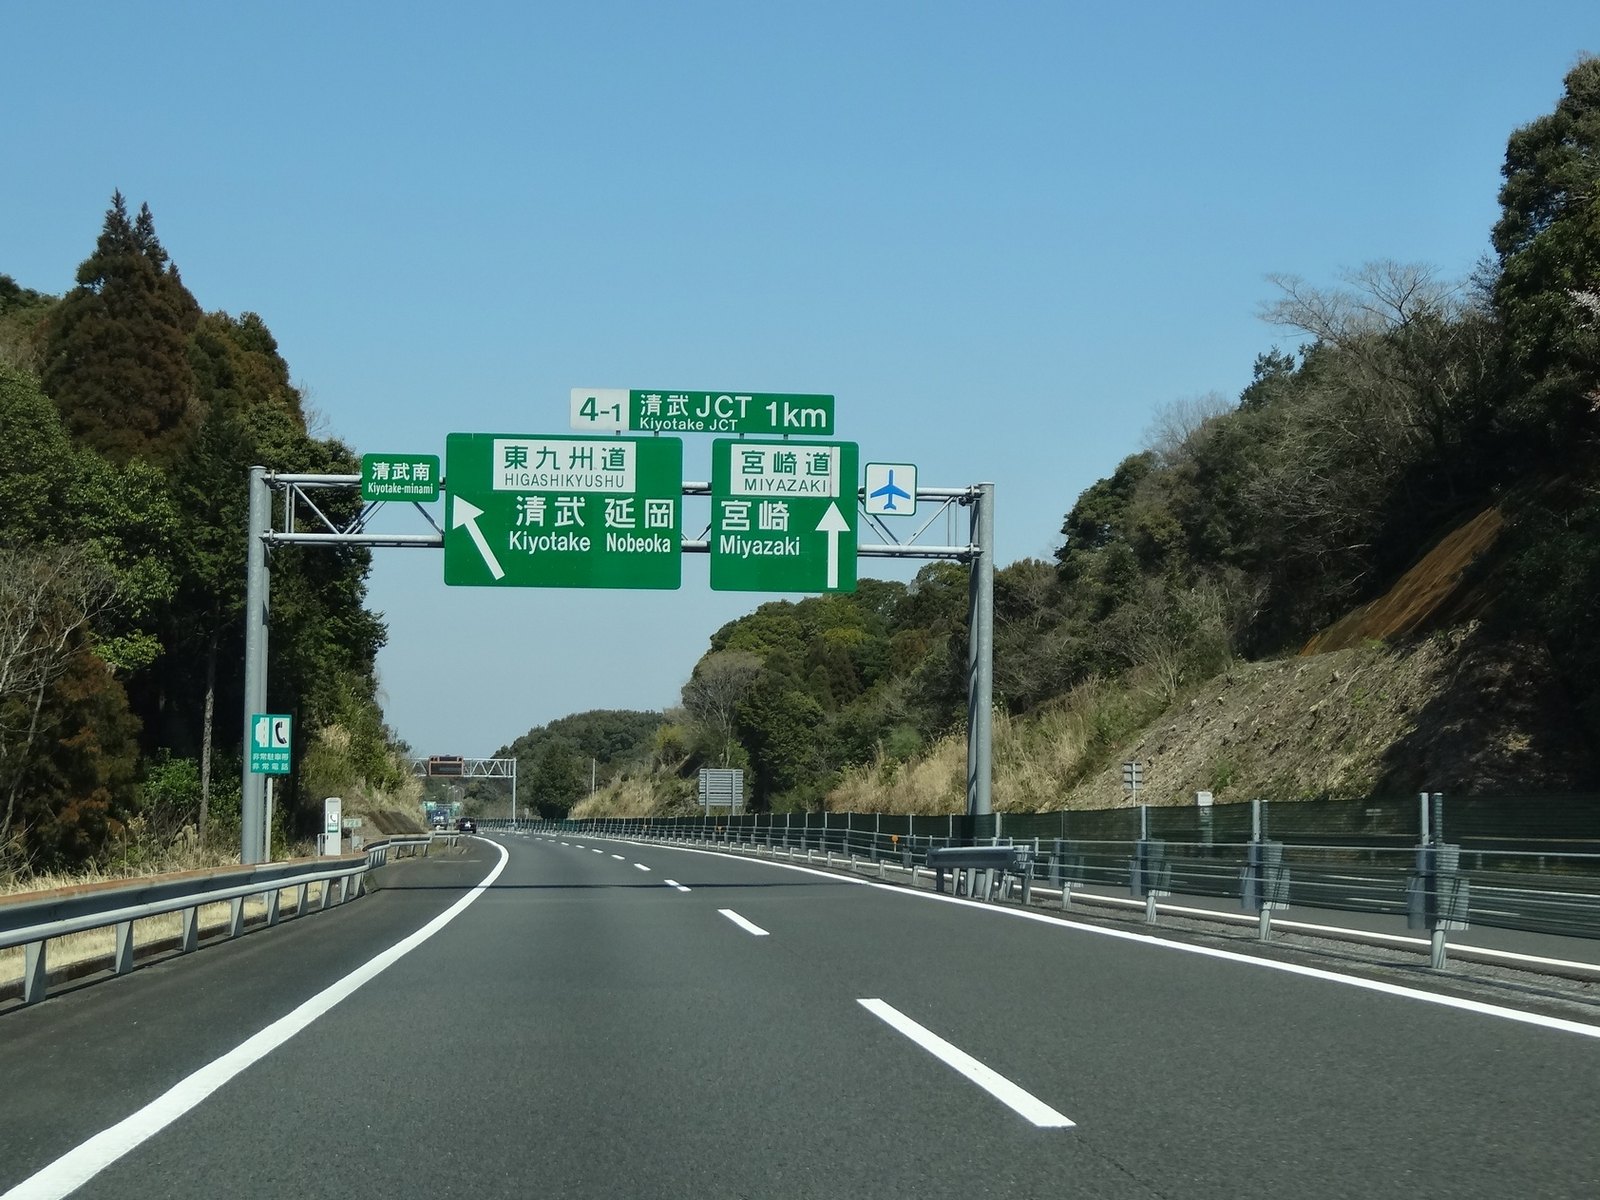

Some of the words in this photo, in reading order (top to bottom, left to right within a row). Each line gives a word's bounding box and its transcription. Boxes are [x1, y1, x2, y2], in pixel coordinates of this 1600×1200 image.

[579, 397, 622, 423] 4-1
[640, 394, 689, 417] 清武
[696, 395, 752, 419] JCT
[766, 402, 827, 428] 1km
[640, 418, 705, 431] Kiyotake
[709, 419, 738, 431] JCT
[504, 445, 626, 472] 東九州道
[741, 451, 830, 476] 宮崎道
[372, 462, 430, 481] 清武南
[504, 473, 625, 488] HIGASHIKYUSHU
[368, 482, 433, 495] Kiyotake-minami
[744, 478, 827, 493] MIYAZAKI
[516, 495, 586, 527] 清武
[604, 498, 674, 530] 延岡
[720, 500, 790, 531] 宮崎
[508, 530, 591, 555] Kiyotake
[606, 532, 671, 553] Nobeoka
[719, 534, 800, 558] Miyazaki
